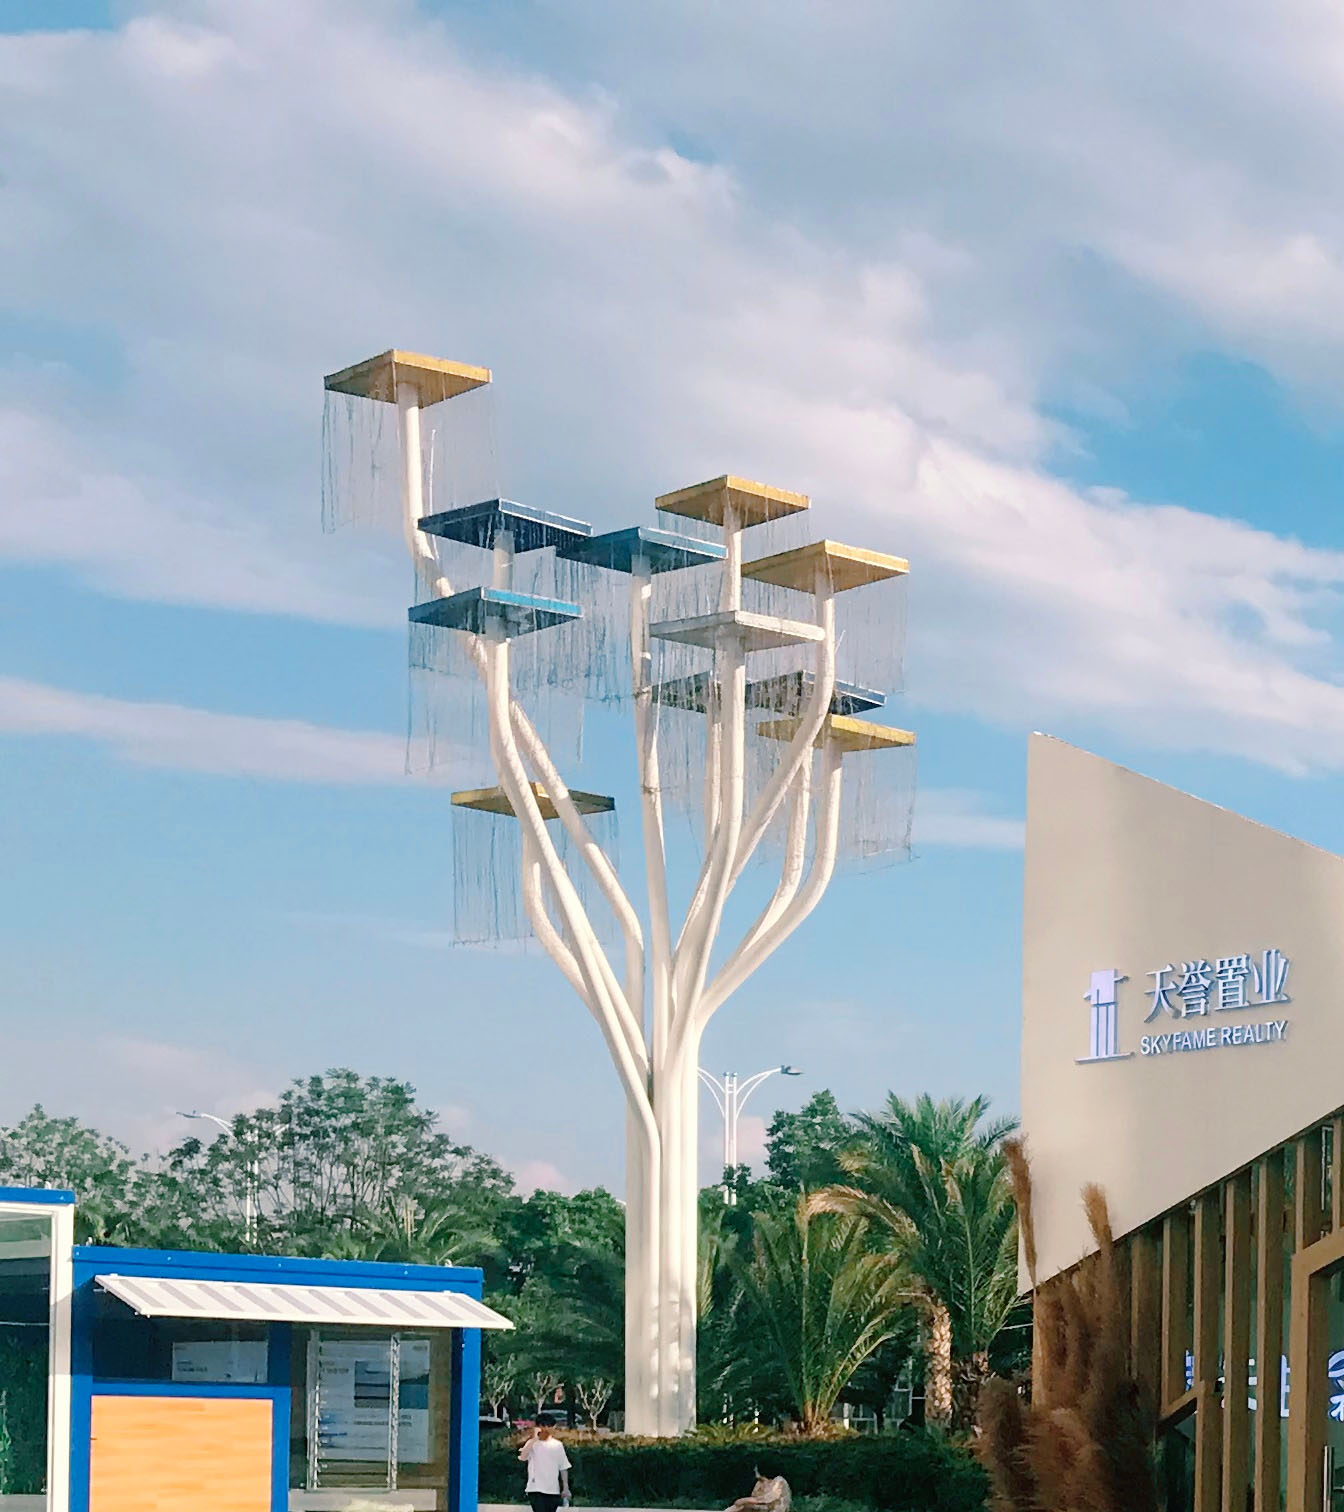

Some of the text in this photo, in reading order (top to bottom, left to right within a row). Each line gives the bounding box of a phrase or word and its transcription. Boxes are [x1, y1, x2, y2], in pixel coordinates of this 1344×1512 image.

[1144, 948, 1293, 1024] 天誉置业
[1139, 1019, 1289, 1056] SKYFAME REALTY
